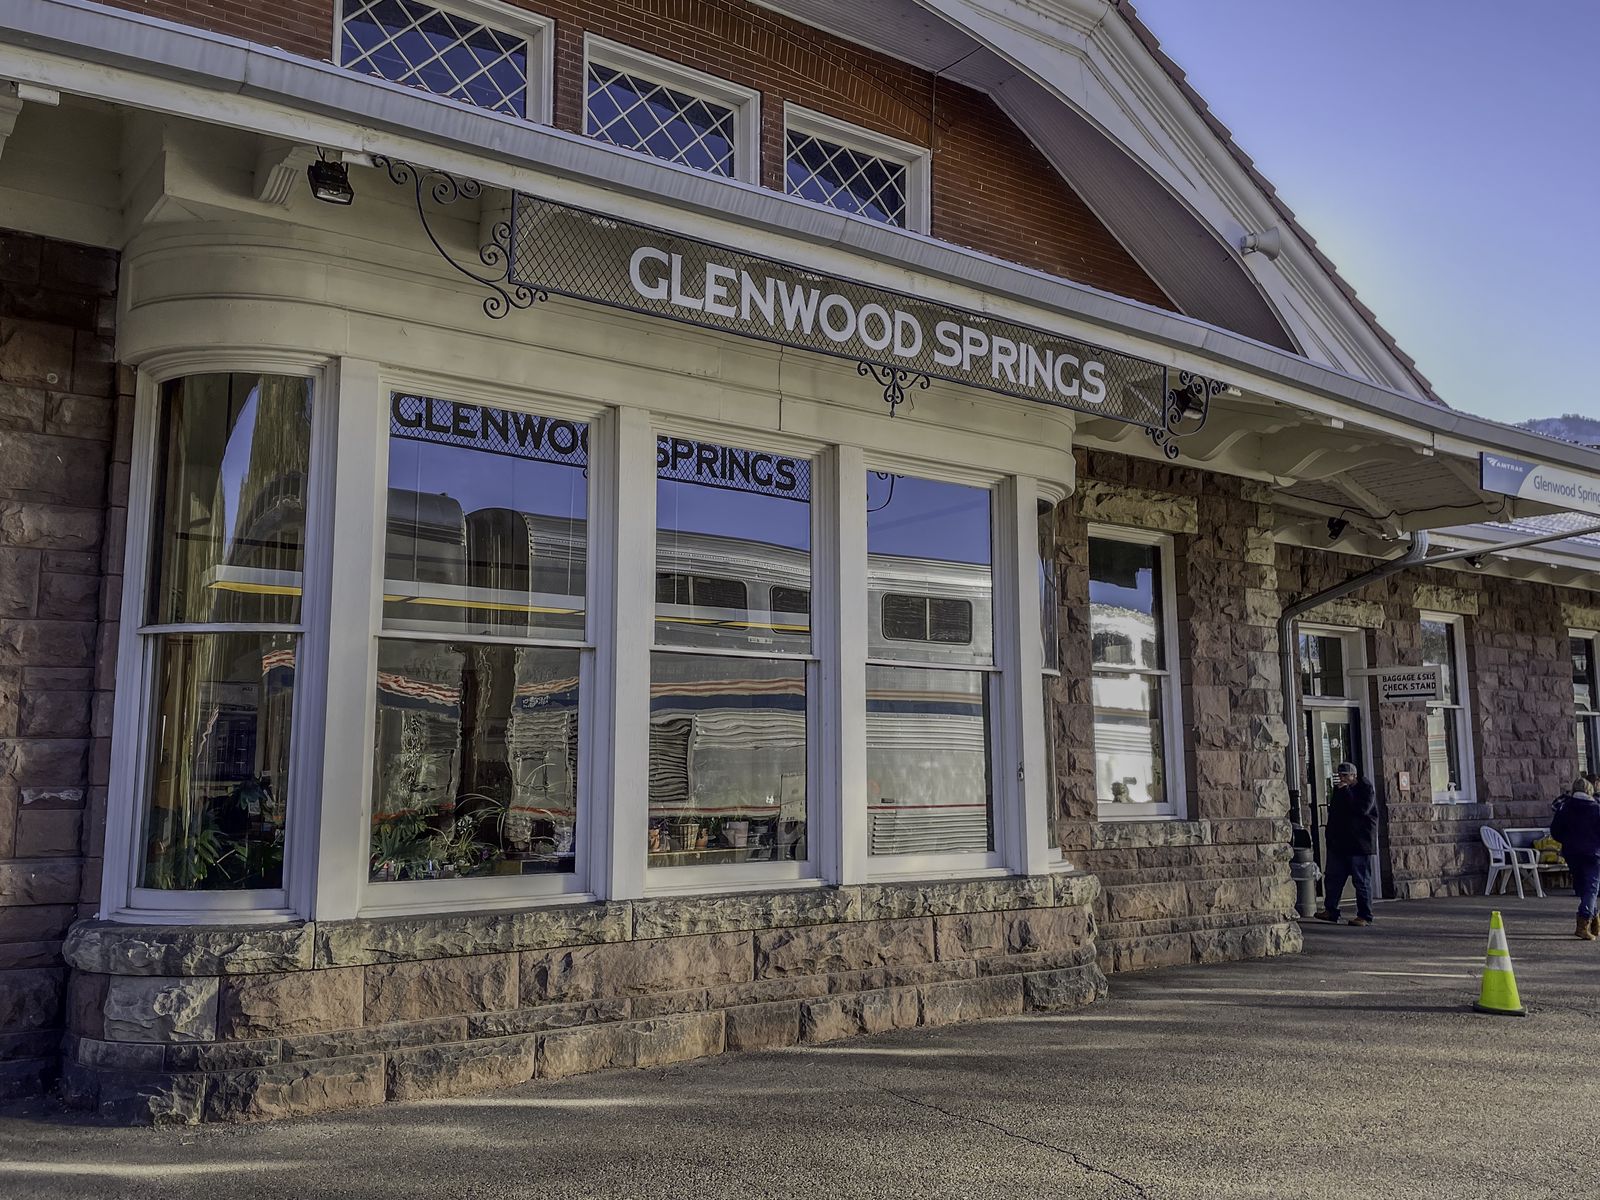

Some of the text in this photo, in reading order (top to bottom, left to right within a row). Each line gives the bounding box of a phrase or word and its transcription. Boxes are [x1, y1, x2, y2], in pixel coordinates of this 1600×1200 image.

[629, 246, 1107, 405] GLENWOOD SPRINGS
[1497, 461, 1523, 473] AMTRAK
[1533, 475, 1576, 498] Glenwood
[1382, 674, 1415, 683] BAGGAGE
[1422, 672, 1436, 681] SKIS
[1382, 682, 1436, 692] CHECK STAND
